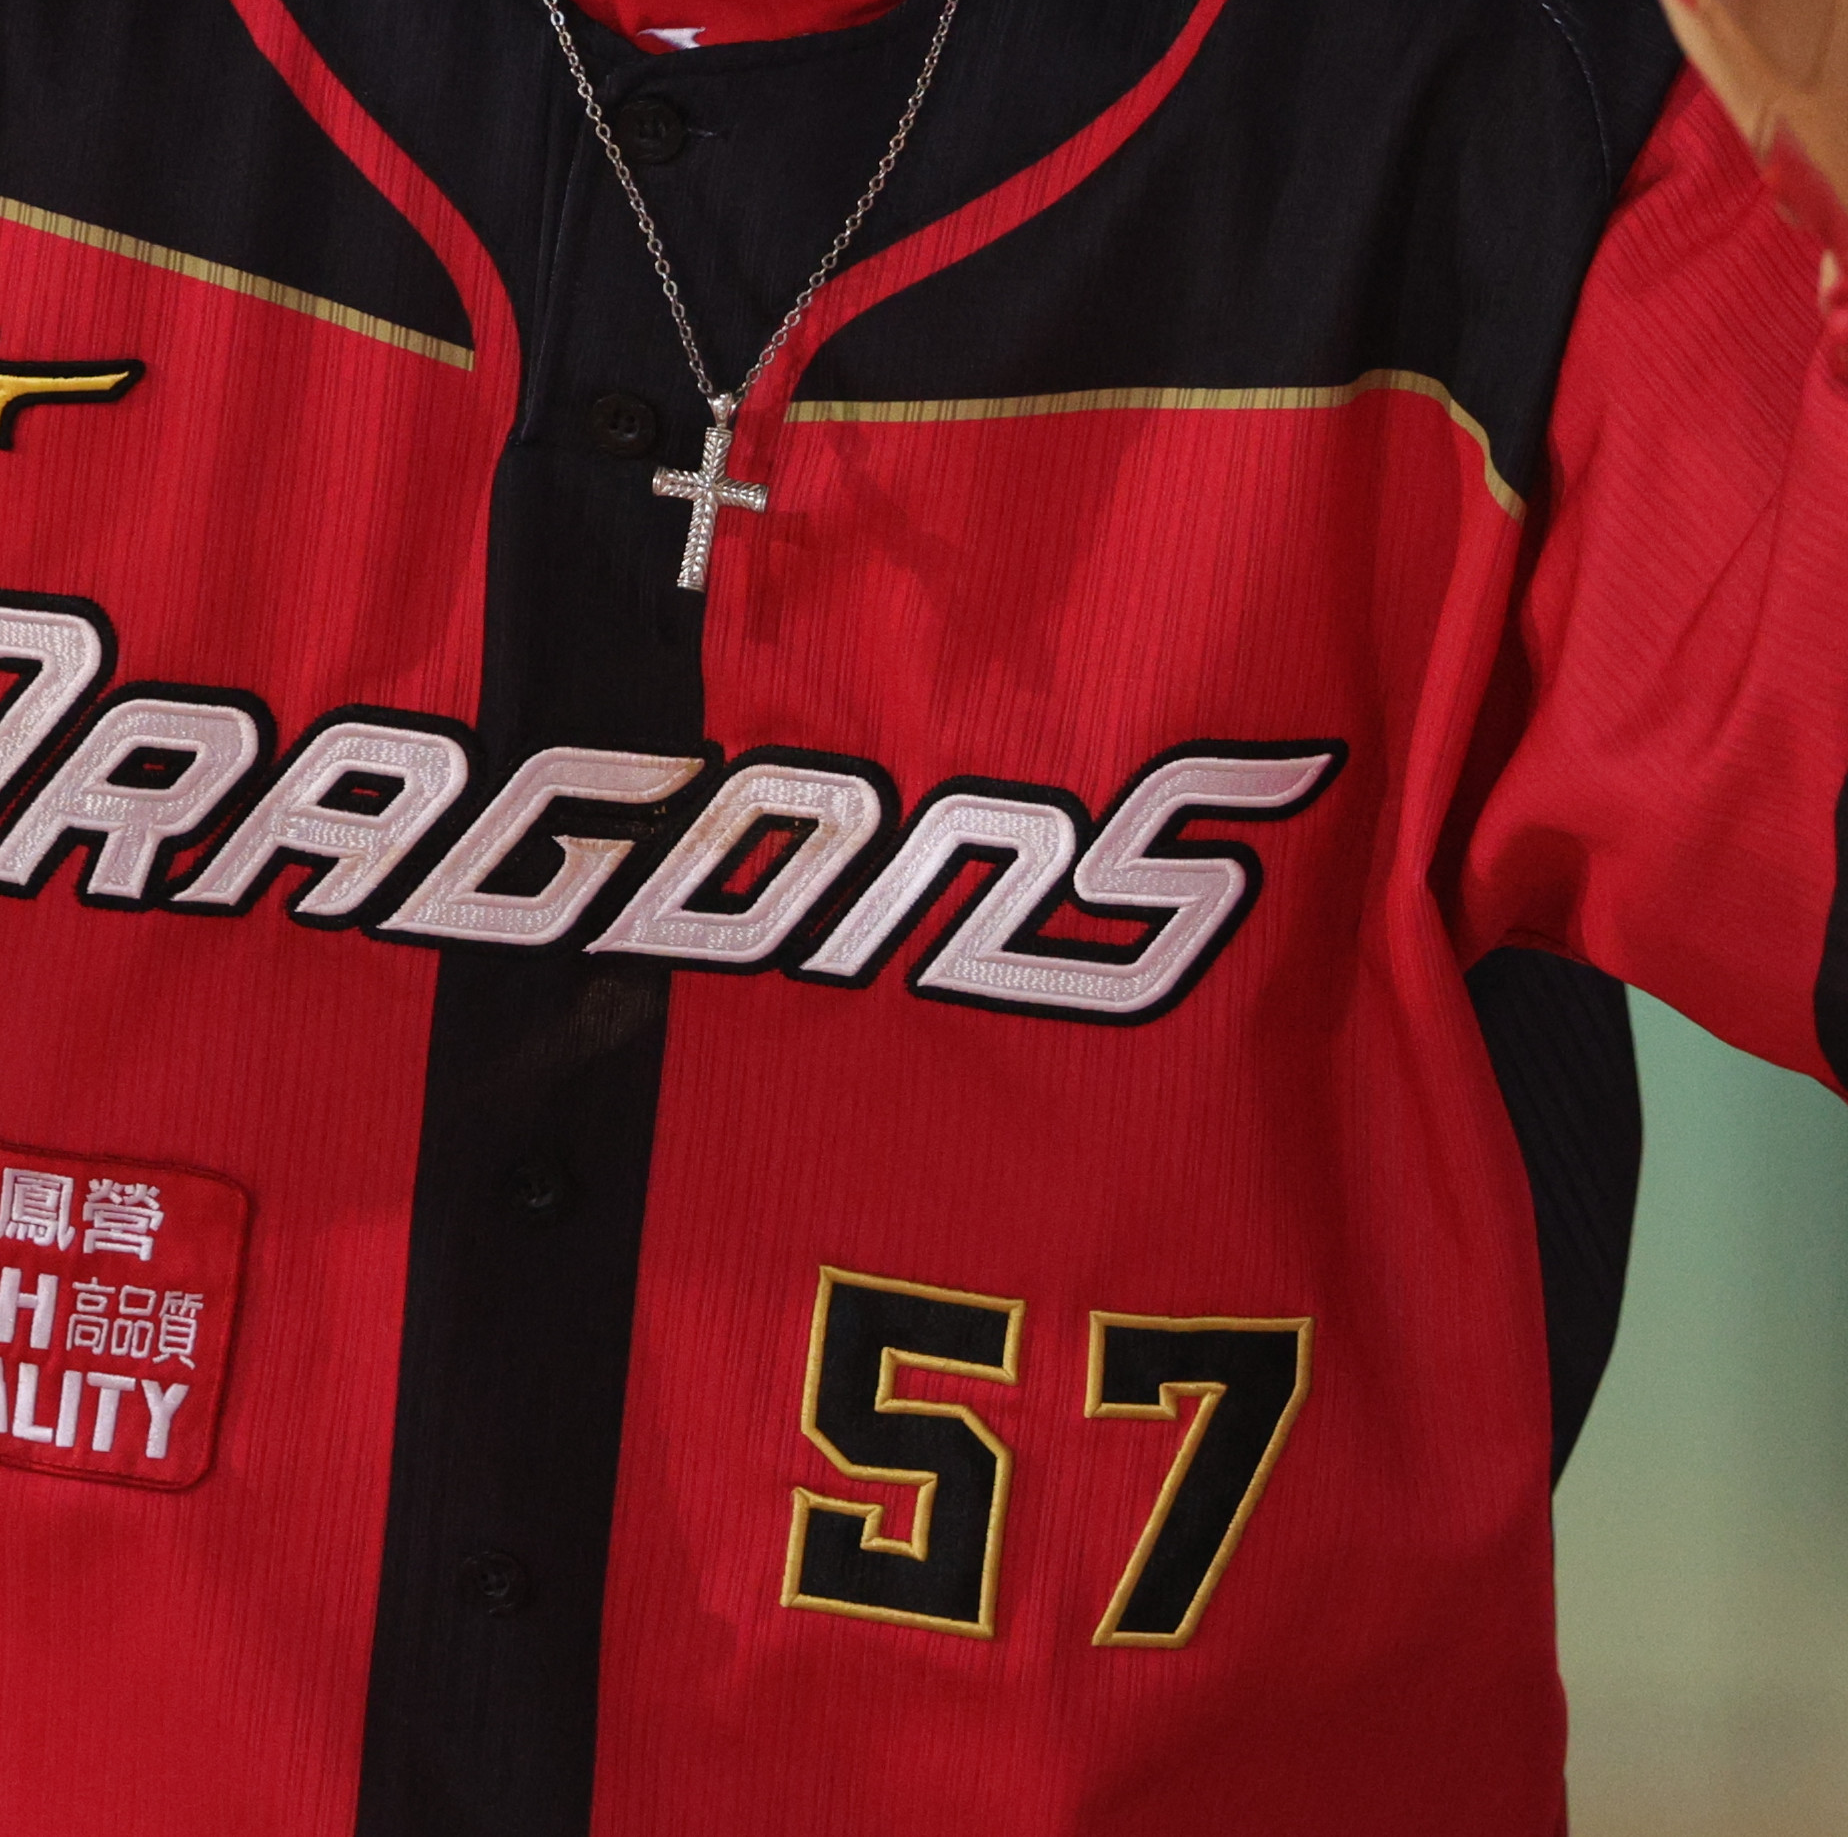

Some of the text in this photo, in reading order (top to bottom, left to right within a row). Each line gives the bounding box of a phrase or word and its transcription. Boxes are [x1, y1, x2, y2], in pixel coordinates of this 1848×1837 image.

[66, 1276, 204, 1370] 高品質
[780, 1264, 1315, 1649] 57
